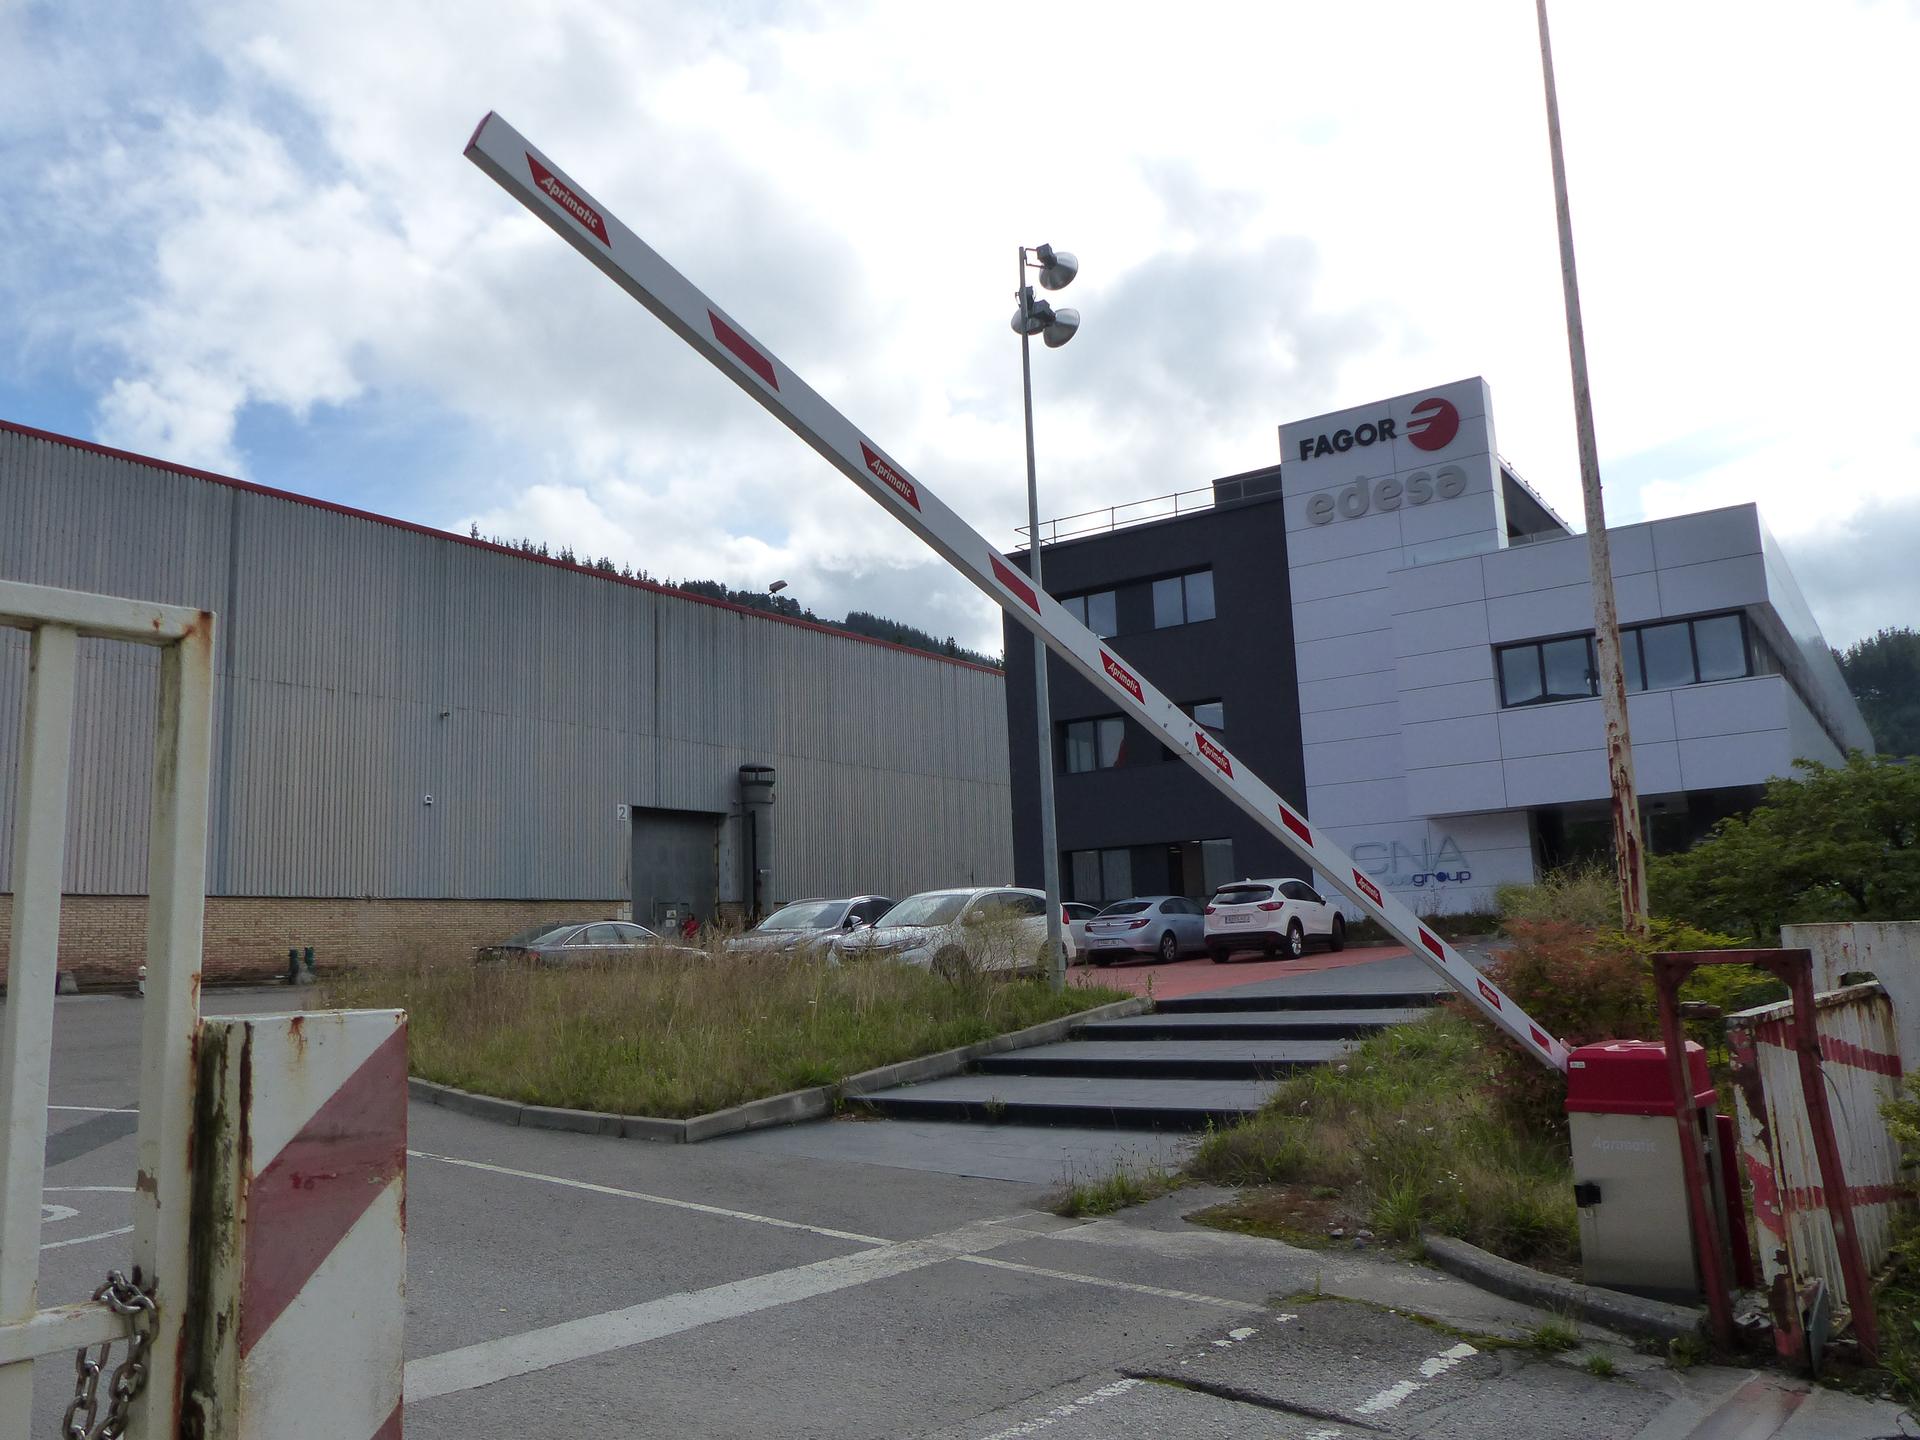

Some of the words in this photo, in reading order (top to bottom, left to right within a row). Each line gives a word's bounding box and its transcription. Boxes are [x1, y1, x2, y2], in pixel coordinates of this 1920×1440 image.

[541, 176, 598, 229] Aprimatic
[1299, 418, 1397, 461] FAGOR
[871, 458, 911, 498] Aprimatic
[1307, 465, 1466, 524] edesa
[1107, 662, 1139, 694] Aprimatic
[1200, 741, 1229, 770] Aprimatic
[618, 807, 627, 820] 2
[1412, 870, 1471, 887] group
